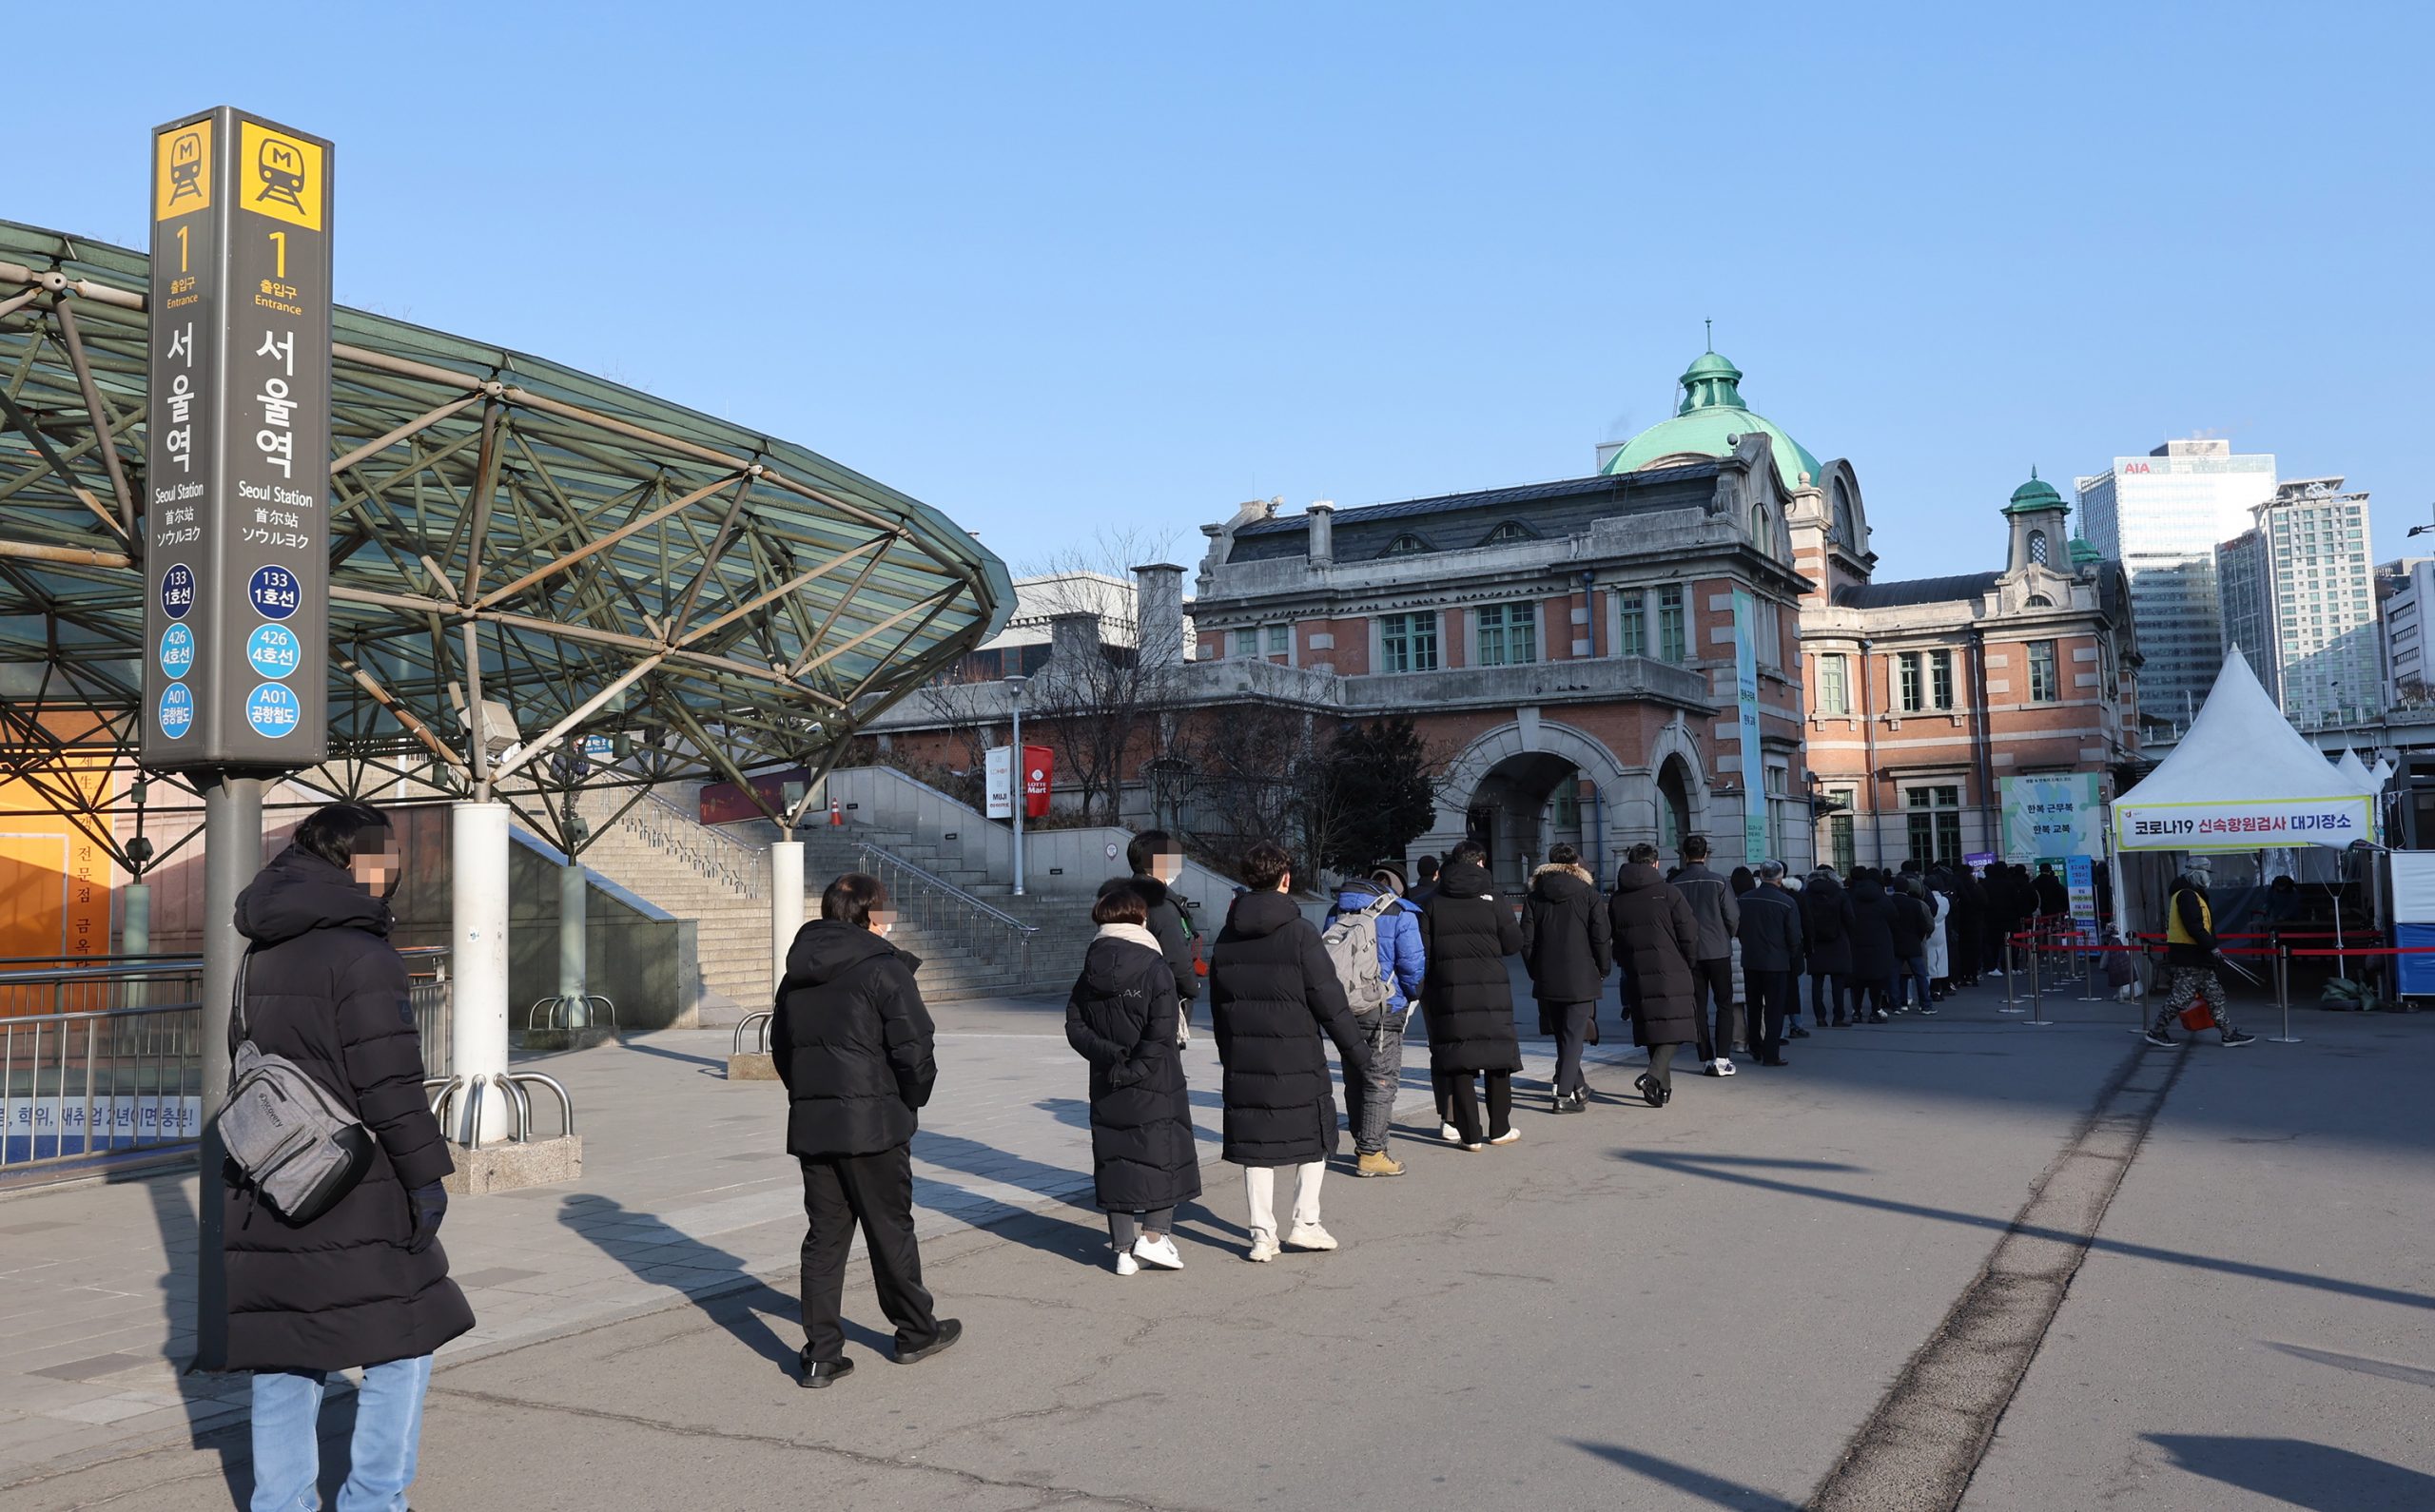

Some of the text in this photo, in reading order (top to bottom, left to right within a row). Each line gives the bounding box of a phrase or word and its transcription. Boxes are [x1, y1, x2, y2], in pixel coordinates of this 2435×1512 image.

[180, 142, 192, 160] M
[273, 147, 291, 168] M
[177, 225, 188, 272] 1
[269, 231, 285, 279] 1
[169, 277, 195, 295] 출입구
[260, 279, 297, 300] 출입구
[167, 293, 198, 309] Entrance
[255, 295, 302, 316] Entrance
[166, 321, 195, 473] 서울역
[256, 330, 298, 479] 서울역
[2125, 463, 2150, 474] AIA
[155, 482, 204, 505] Seoul Station
[239, 480, 313, 508] Seoul Station
[165, 506, 194, 526] 首尔站
[254, 507, 299, 529] 首尔站
[157, 525, 201, 548] ソウルヨク
[242, 527, 309, 550] ソウルヨク
[170, 571, 186, 586] 133
[263, 572, 288, 587] 133
[165, 587, 190, 606] 1호선
[255, 588, 295, 609] 1호선
[168, 630, 185, 645] 426
[261, 630, 287, 646] 426
[164, 647, 189, 665] 4호선
[252, 648, 294, 667] 4호선
[167, 690, 185, 704] A01
[260, 689, 286, 704] A01
[163, 707, 189, 726] 공항철도
[251, 706, 295, 724] 공항철도
[2028, 803, 2074, 814] 한복 근무복
[2033, 824, 2071, 834] 한복 교복
[2135, 814, 2351, 835] 코로나19 신속항원검사 대기장소
[77, 846, 91, 903] 전문점
[19, 1107, 53, 1127] 학위,
[161, 1108, 194, 1127] 충분!
